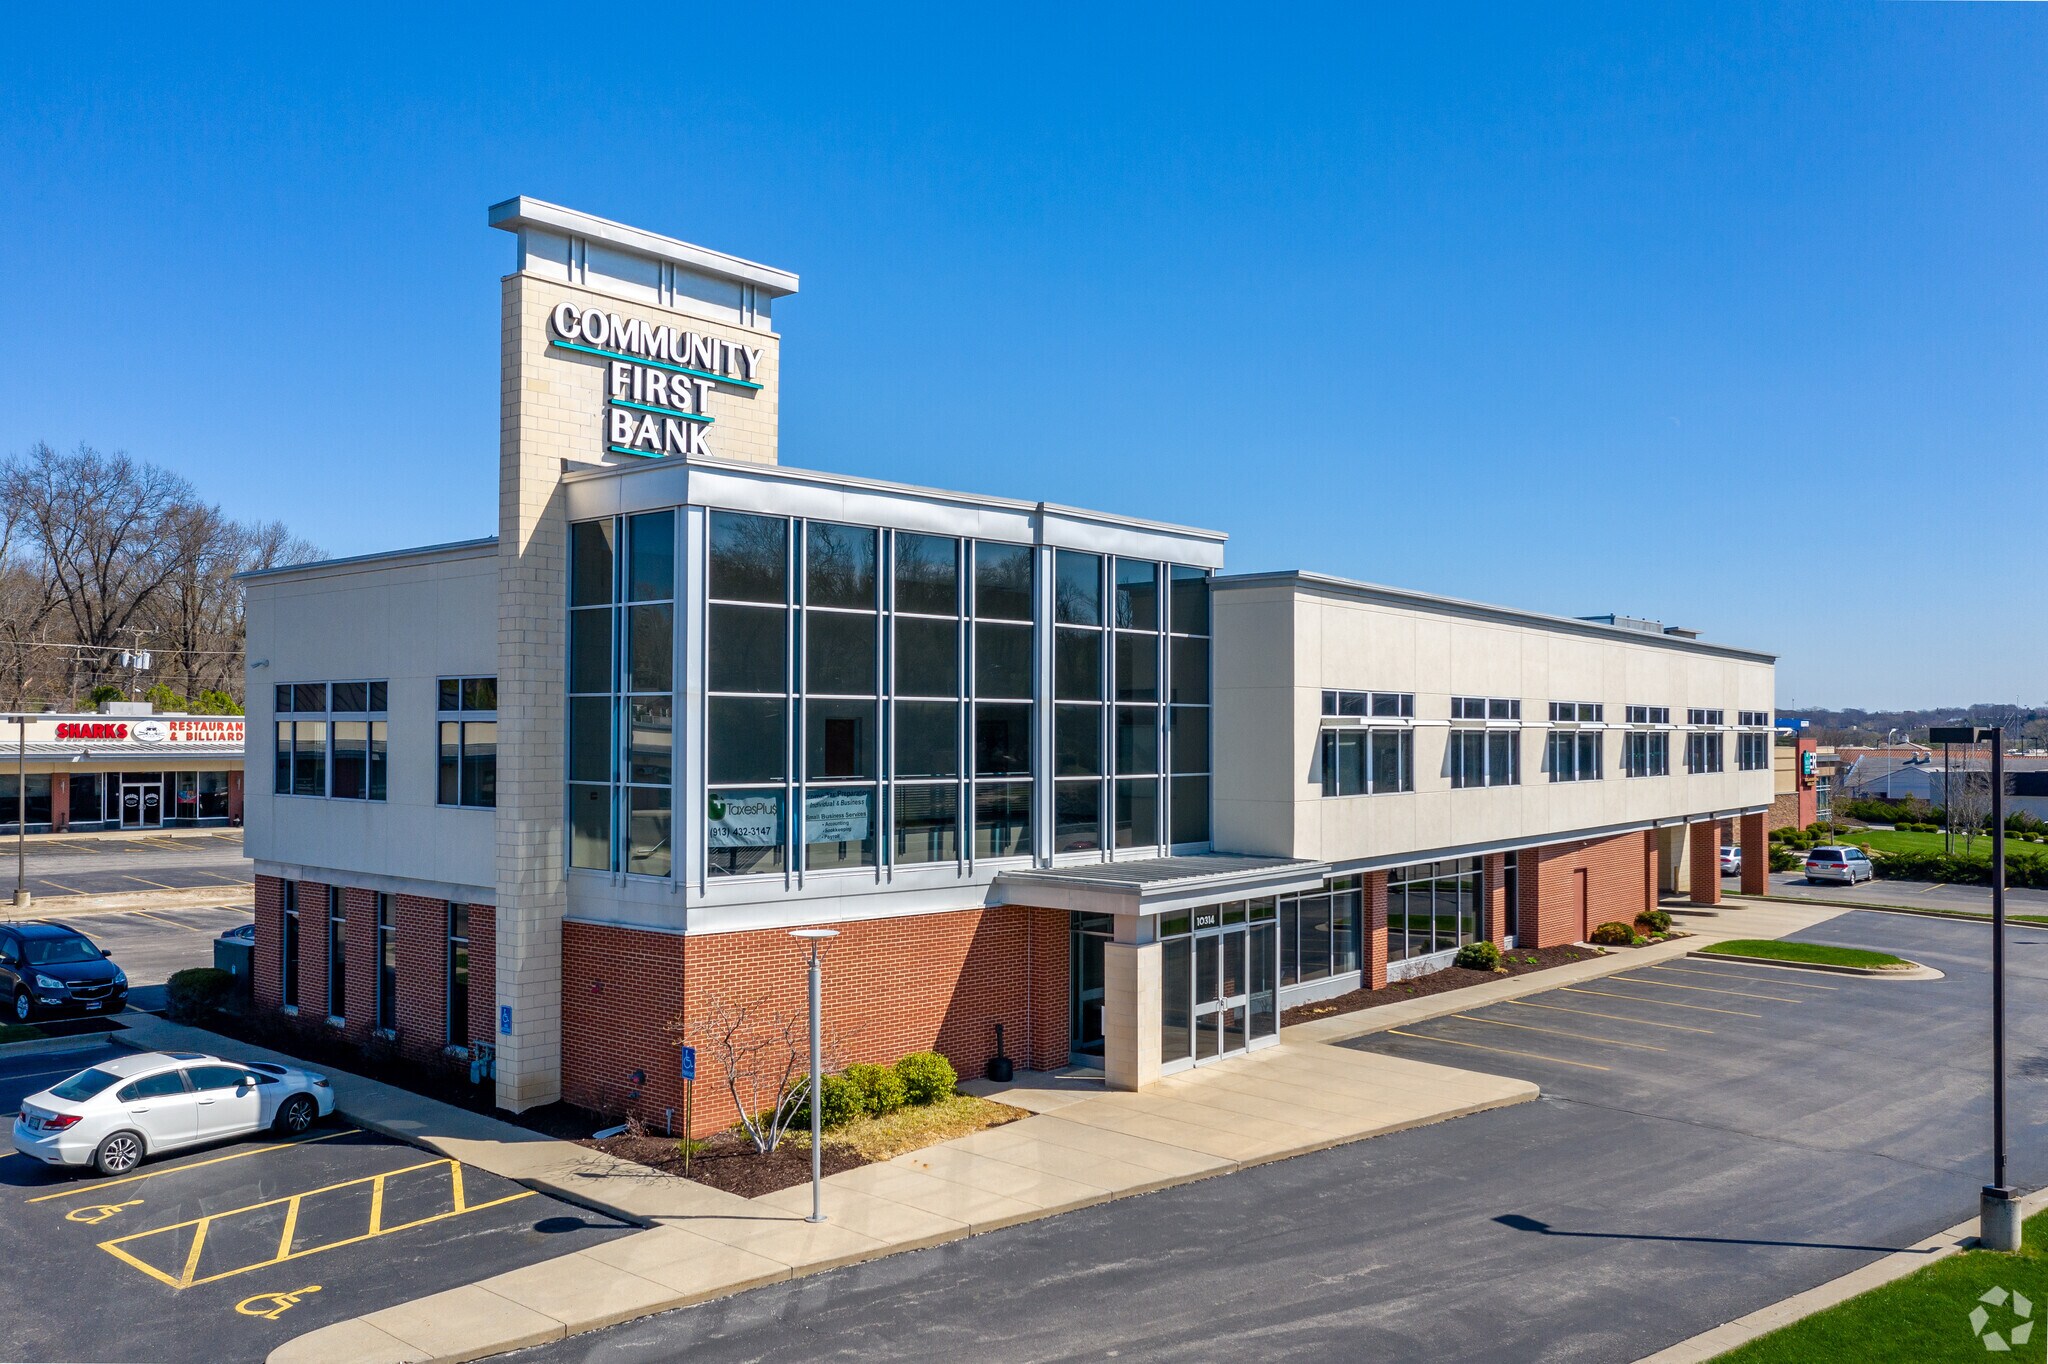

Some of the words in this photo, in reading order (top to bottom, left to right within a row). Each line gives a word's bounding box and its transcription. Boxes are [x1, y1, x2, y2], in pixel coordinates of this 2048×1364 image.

[553, 302, 765, 379] COMMUNITY
[609, 360, 716, 413] FIRST
[609, 408, 714, 456] BANK
[56, 723, 128, 739] SHARKS
[169, 732, 178, 741] &
[710, 827, 730, 838] (913)
[733, 826, 771, 836] 432-3147
[1197, 914, 1215, 926] 10314
